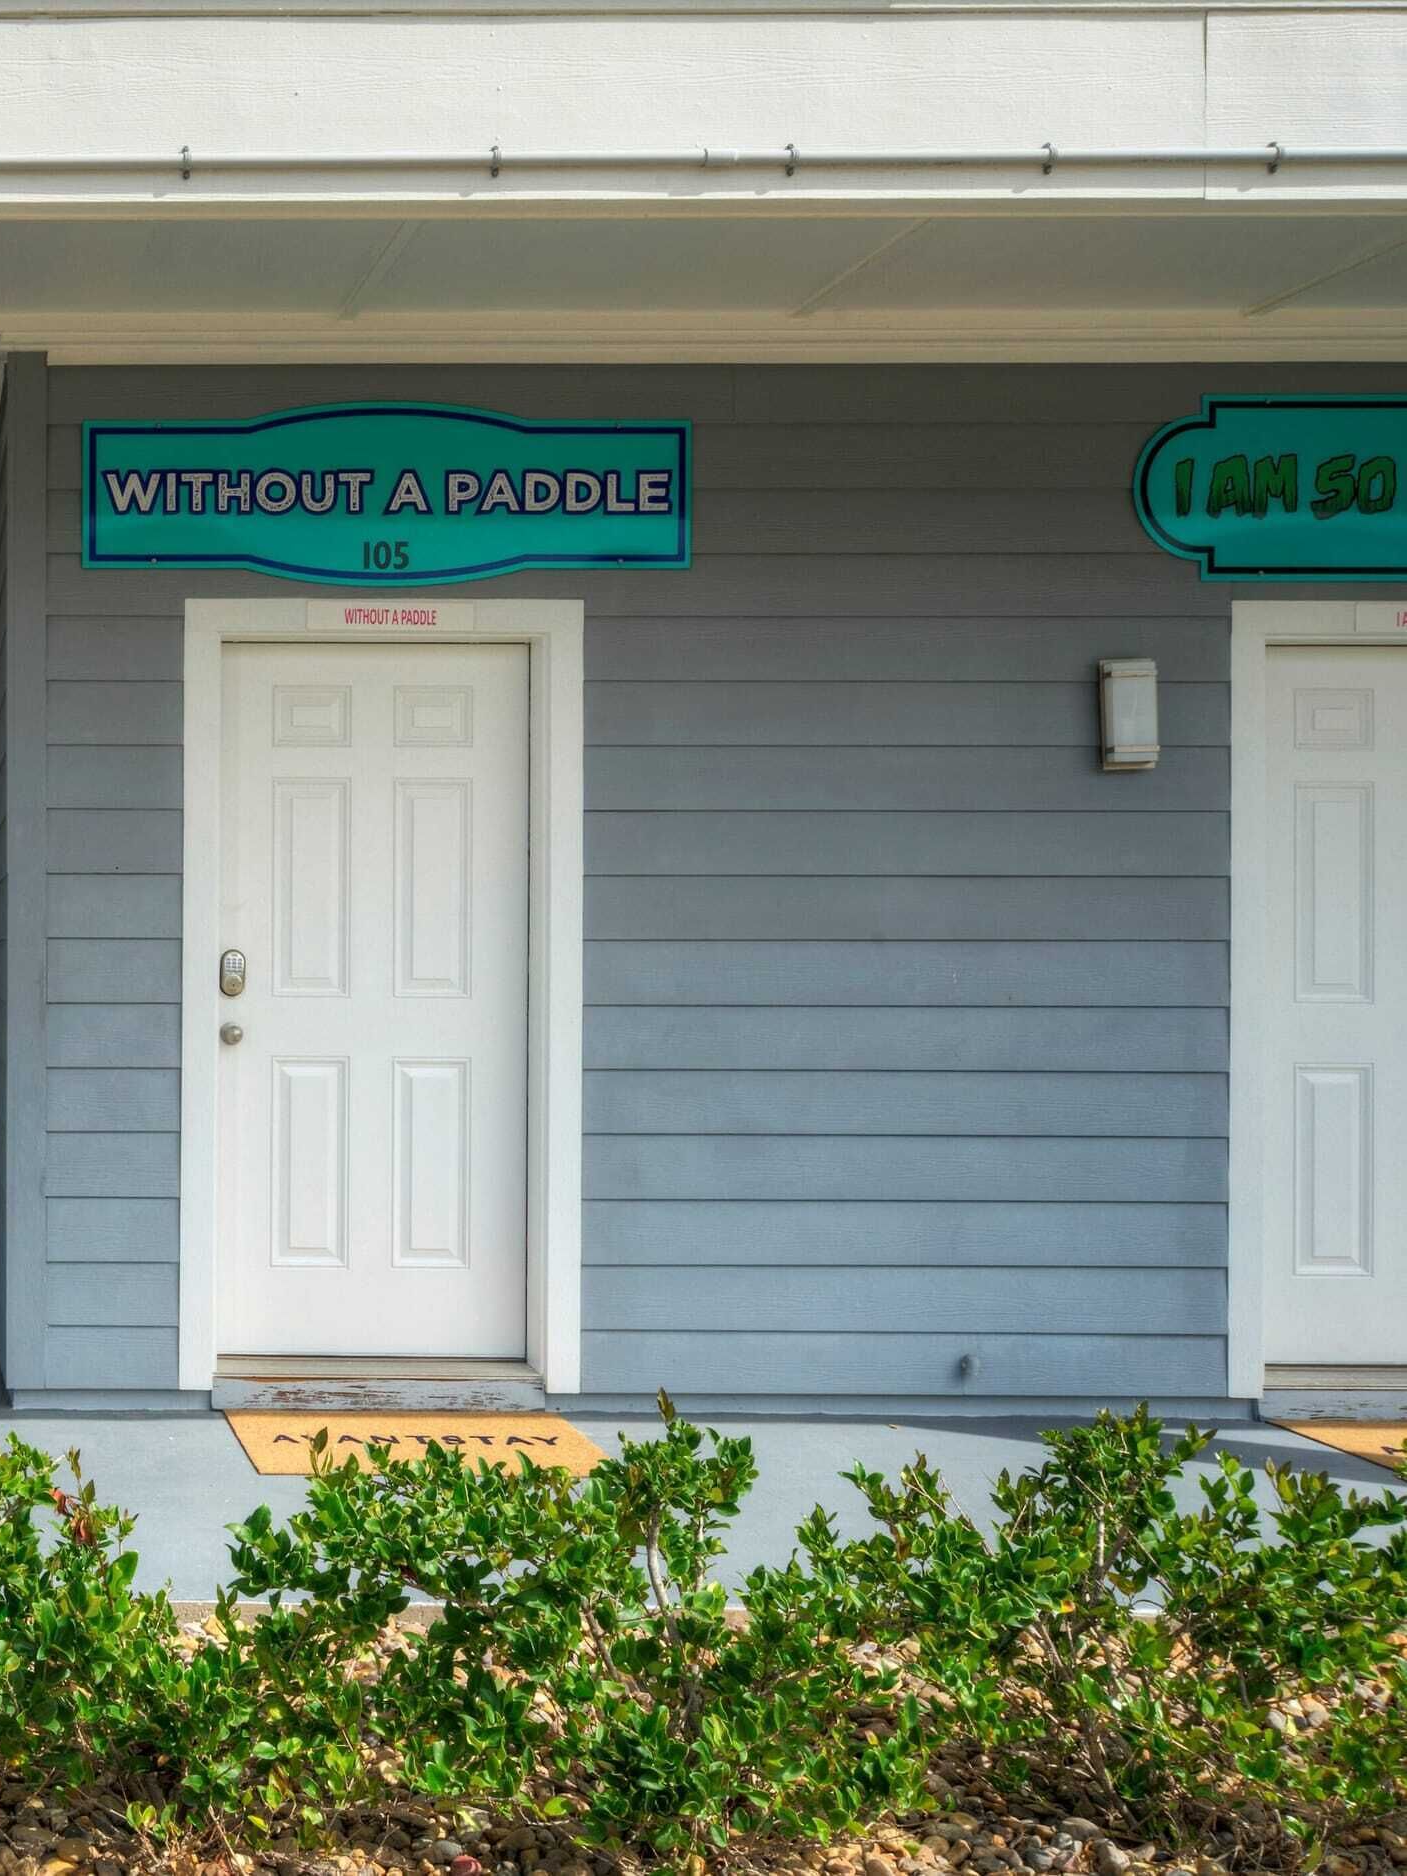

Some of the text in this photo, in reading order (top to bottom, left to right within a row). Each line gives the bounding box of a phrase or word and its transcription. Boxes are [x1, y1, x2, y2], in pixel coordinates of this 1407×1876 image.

[103, 469, 671, 514] WITHOUT A PADDLE
[1175, 453, 1396, 519] I AM SO
[362, 541, 409, 569] 105
[344, 608, 437, 625] WITHOUT A PADDLE
